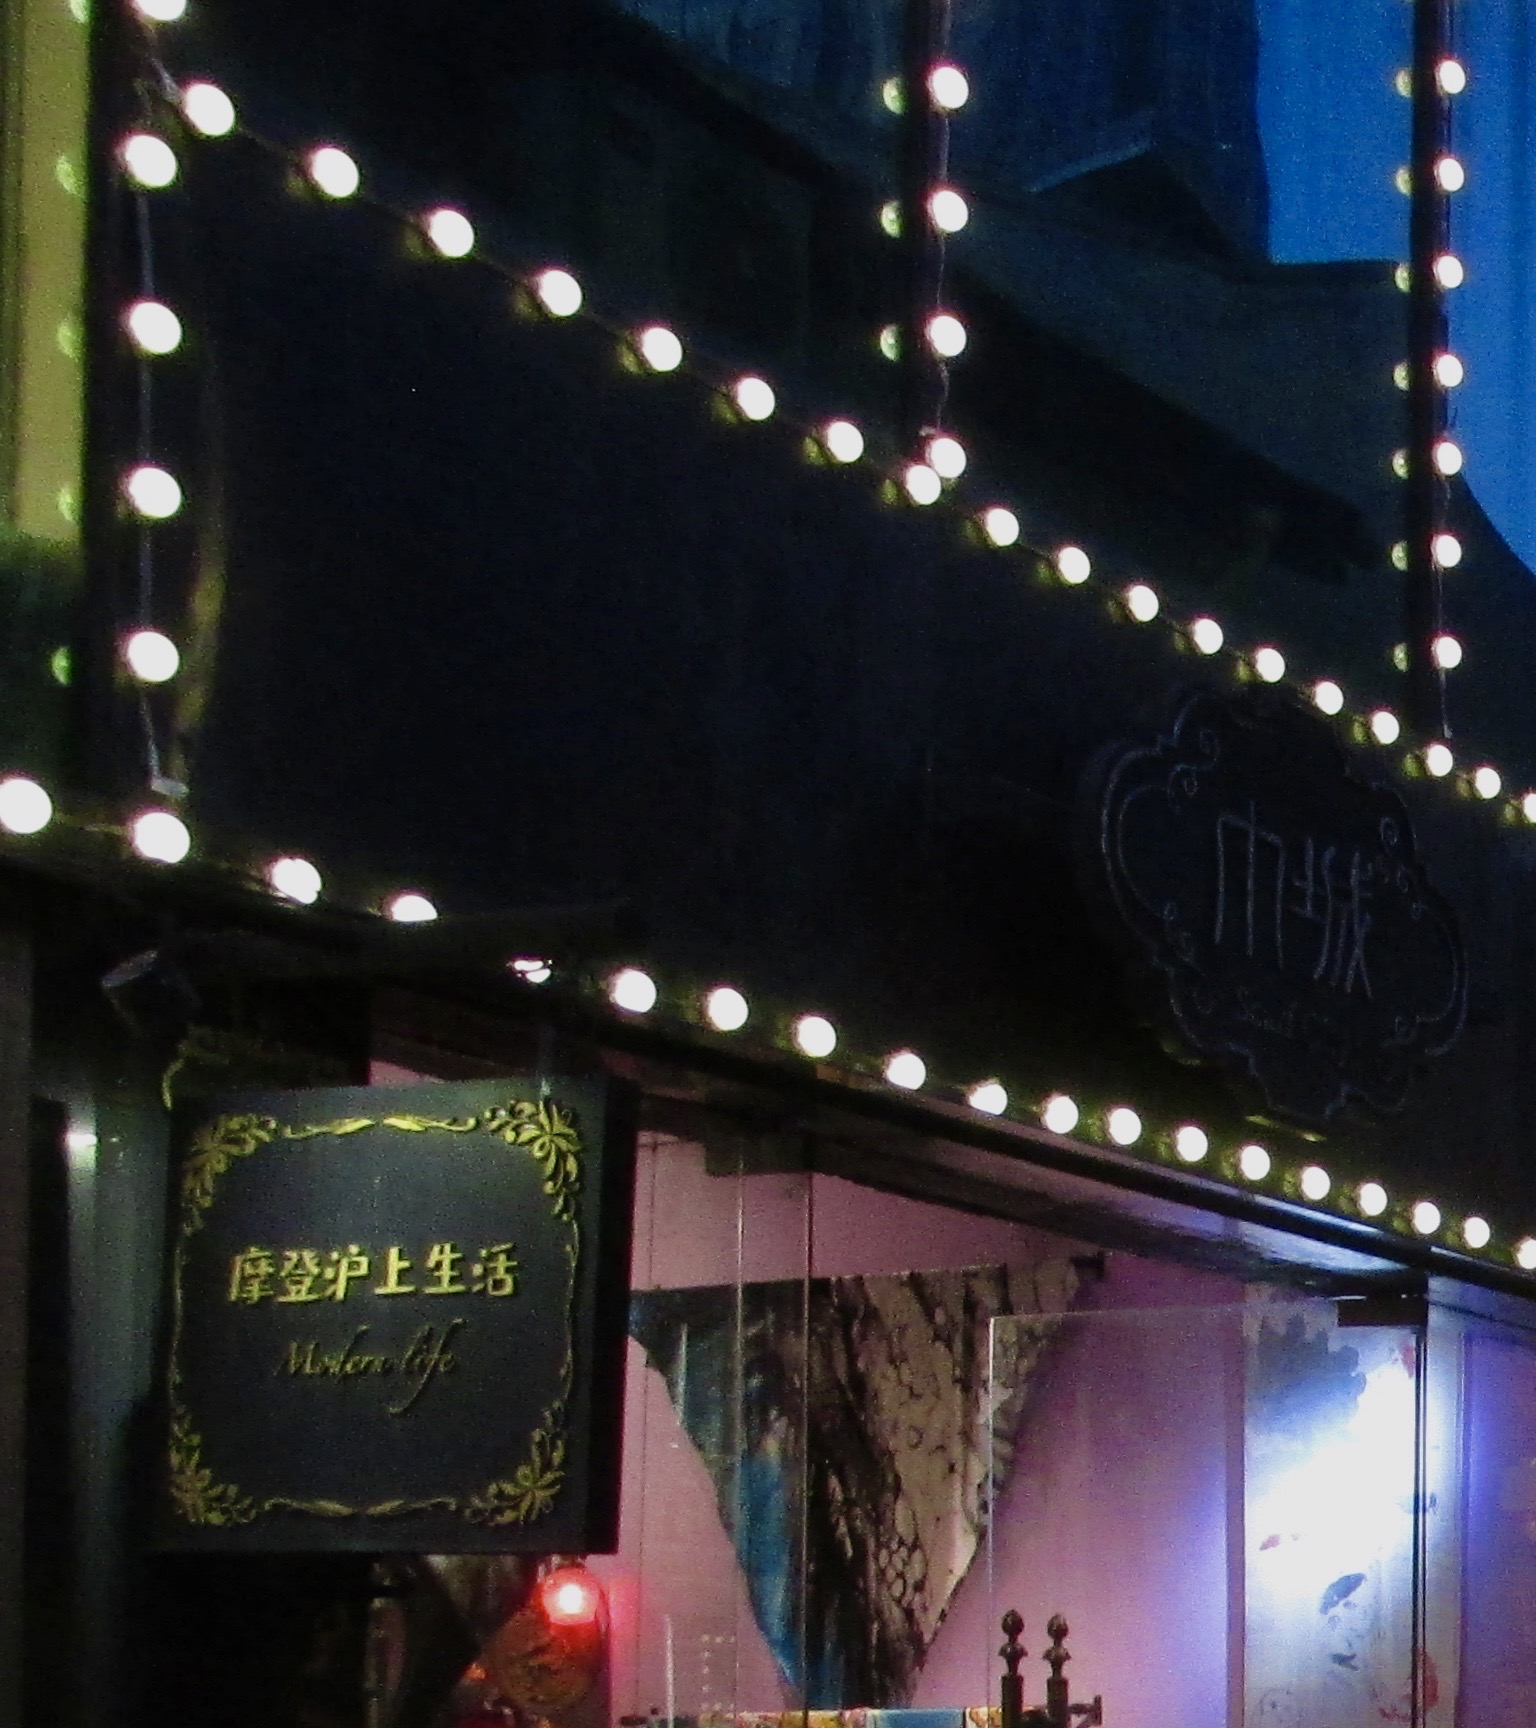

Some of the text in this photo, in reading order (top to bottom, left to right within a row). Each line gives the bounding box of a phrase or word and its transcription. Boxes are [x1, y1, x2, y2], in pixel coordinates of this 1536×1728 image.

[229, 1242, 519, 1302] 摩登沪上生活
